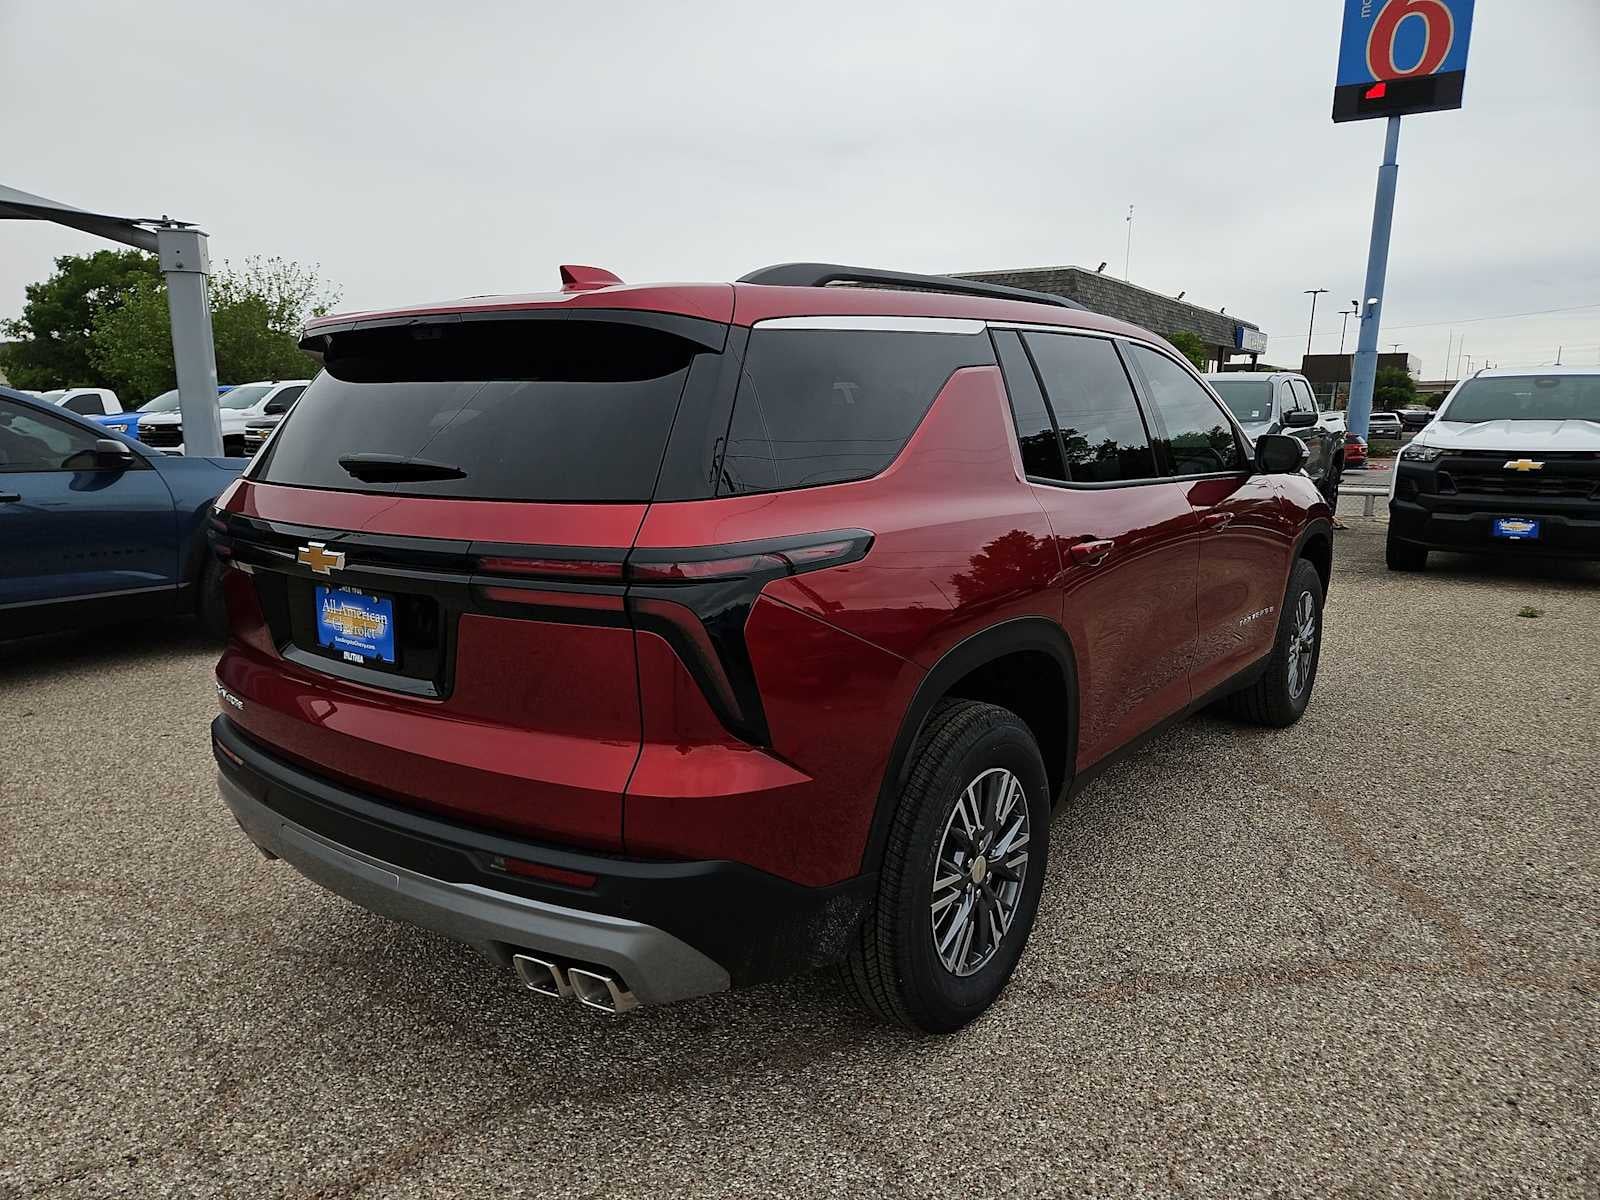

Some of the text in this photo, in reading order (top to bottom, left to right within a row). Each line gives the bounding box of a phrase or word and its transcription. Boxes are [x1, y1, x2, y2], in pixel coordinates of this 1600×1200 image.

[1365, 0, 1455, 81] 6
[322, 598, 388, 625] All American
